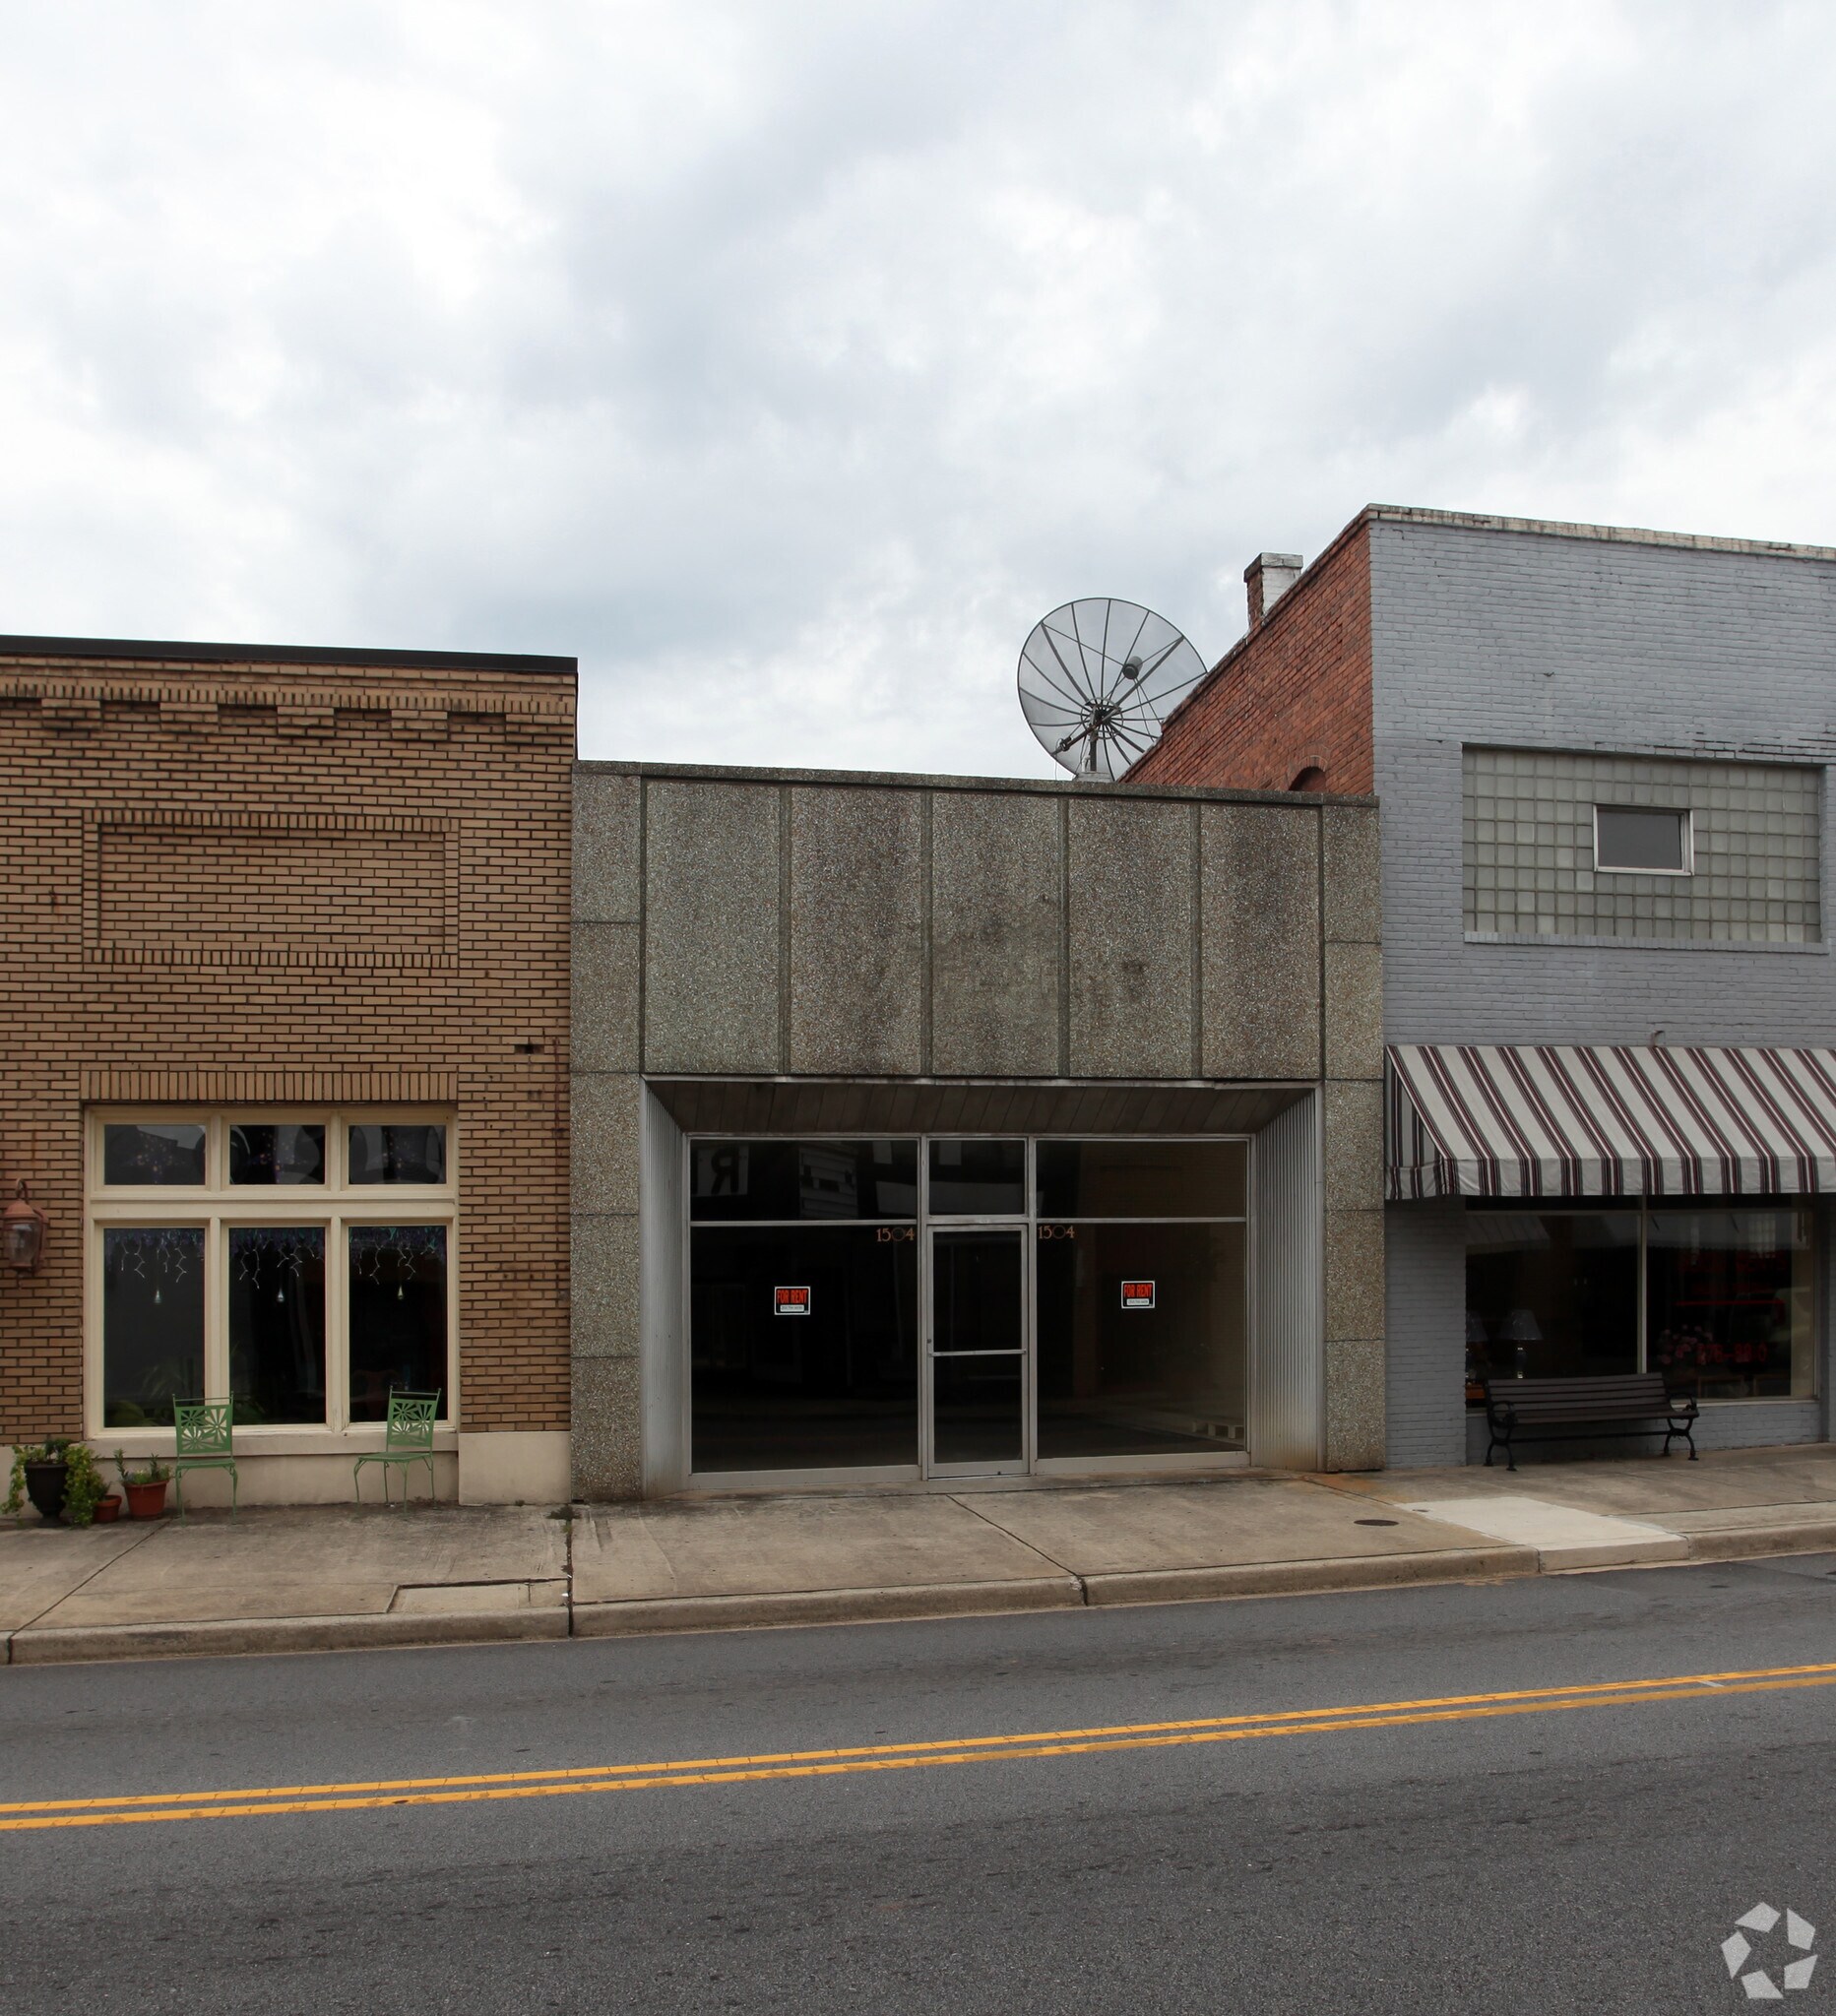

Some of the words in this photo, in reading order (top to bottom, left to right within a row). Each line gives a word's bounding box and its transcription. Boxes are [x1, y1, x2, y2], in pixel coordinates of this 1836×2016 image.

[876, 1227, 915, 1242] 1504
[1038, 1225, 1075, 1239] 1504
[777, 1290, 789, 1304] FOR
[791, 1290, 807, 1304] RENT
[1124, 1284, 1135, 1297] FOR
[1137, 1284, 1152, 1297] RENT
